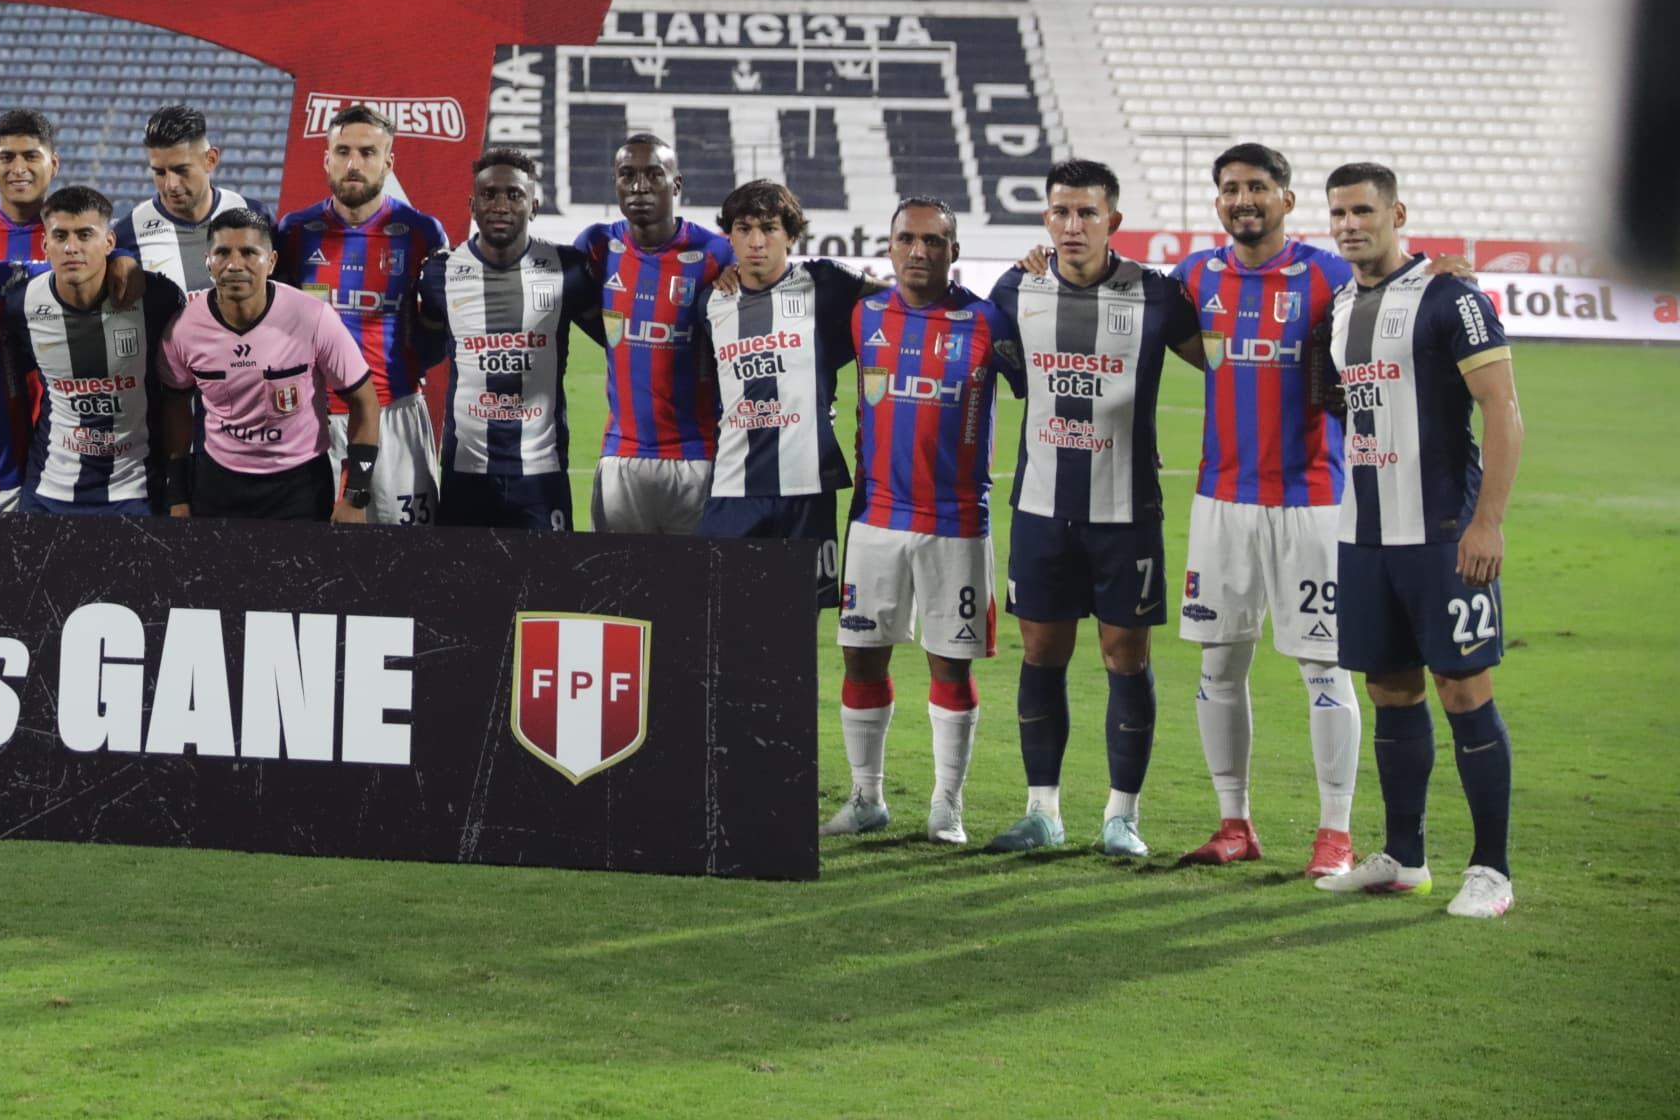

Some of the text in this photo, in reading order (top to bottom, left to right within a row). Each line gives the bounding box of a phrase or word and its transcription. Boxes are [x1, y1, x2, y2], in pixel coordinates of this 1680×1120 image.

[331, 289, 403, 312] UDH
[624, 318, 694, 344] UDH
[1456, 296, 1480, 346] TORITO
[1465, 294, 1490, 344] LOTERIAS
[463, 330, 548, 353] apuesta
[719, 331, 801, 362] apuesta
[1225, 337, 1302, 362] UDH
[230, 360, 257, 368] walon
[478, 353, 532, 372] total
[732, 354, 786, 380] total
[1032, 352, 1124, 374] apuesta
[1341, 360, 1401, 384] uesta
[52, 374, 137, 395] apuesta
[888, 373, 963, 402] UDH
[1048, 373, 1104, 397] total
[70, 395, 122, 414] total
[499, 394, 525, 407] Caja
[755, 400, 782, 413] Caja
[1347, 387, 1383, 410] otal
[468, 404, 543, 421] Huancayo
[728, 411, 801, 429] Huancayo
[1068, 422, 1095, 435] Caja
[62, 435, 133, 457] Huancayo
[1039, 429, 1114, 453] Huancayo
[397, 493, 432, 526] 33
[1136, 557, 1154, 599] 7
[958, 585, 978, 620] 8
[1298, 579, 1338, 615] 29
[1446, 593, 1497, 643] 22
[57, 600, 416, 767] GANE
